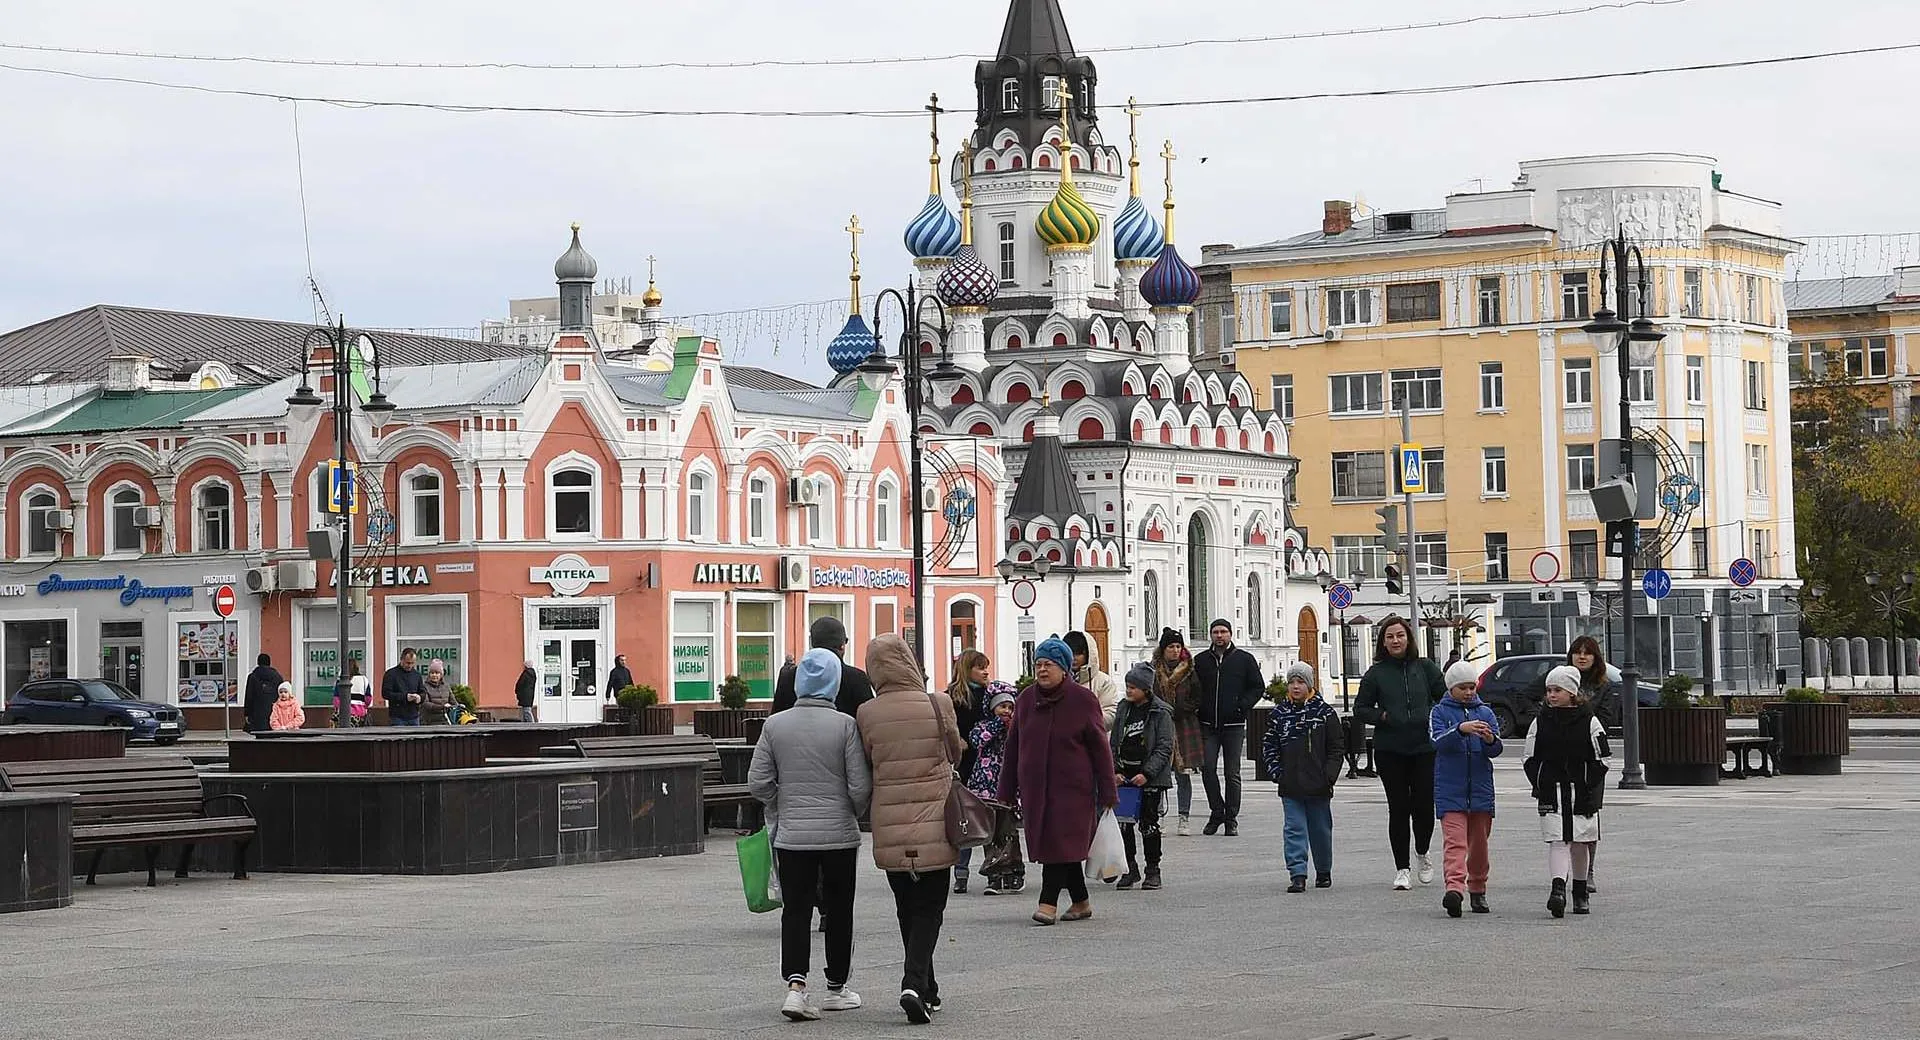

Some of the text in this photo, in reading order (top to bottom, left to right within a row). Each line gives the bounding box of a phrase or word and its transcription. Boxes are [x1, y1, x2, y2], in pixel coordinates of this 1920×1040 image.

[544, 570, 595, 579] АПТЕКА
[695, 563, 763, 583] АПТЕКА
[38, 574, 125, 596] Восточный
[120, 579, 193, 606] Экспресс
[310, 650, 363, 661] НИЗИЕ
[411, 648, 457, 660] ИЗКИЕ
[674, 645, 709, 657] НИЗКИЕ
[678, 661, 705, 674] ЦЕНЫ
